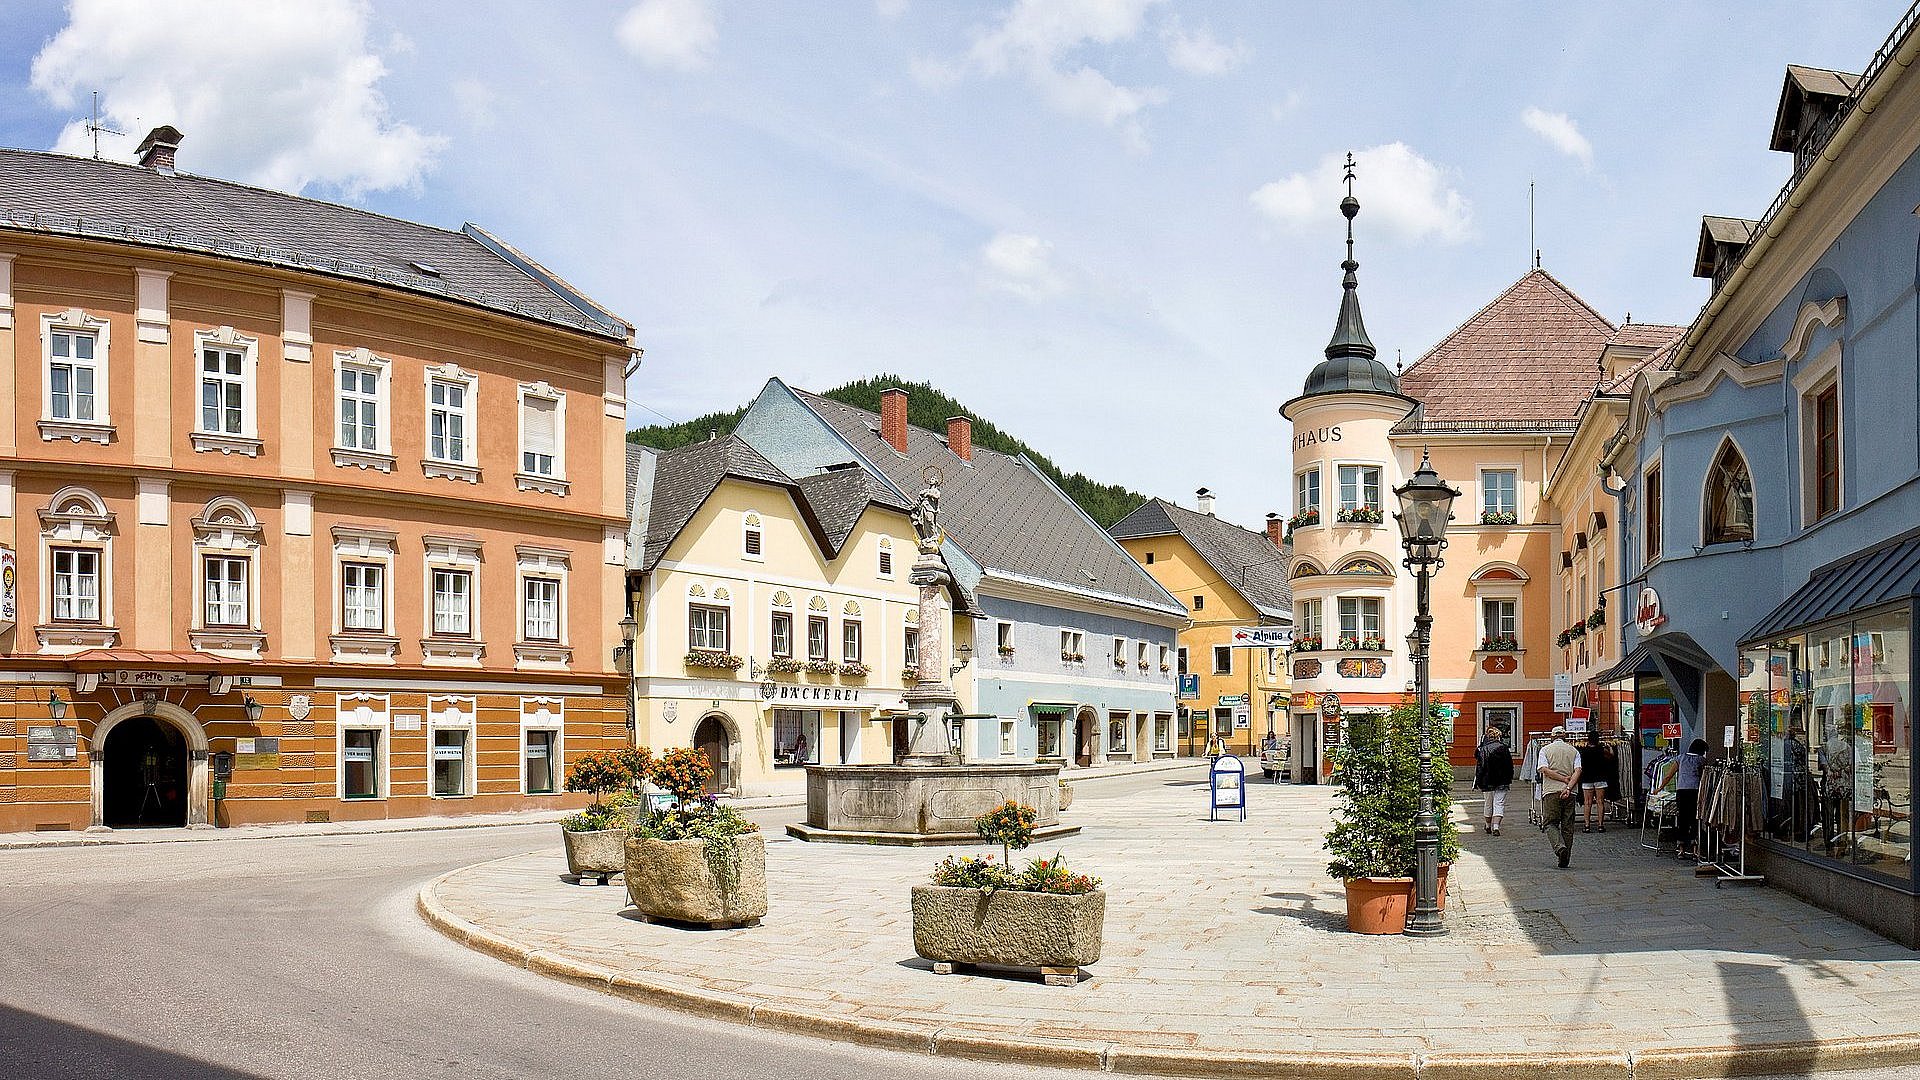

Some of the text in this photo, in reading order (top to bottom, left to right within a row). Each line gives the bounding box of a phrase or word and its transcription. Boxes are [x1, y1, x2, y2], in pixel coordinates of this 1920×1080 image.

[1253, 630, 1283, 643] Alpine
[134, 671, 163, 681] PEPITO
[1185, 679, 1192, 688] P
[780, 686, 859, 701] BÄCKEREI
